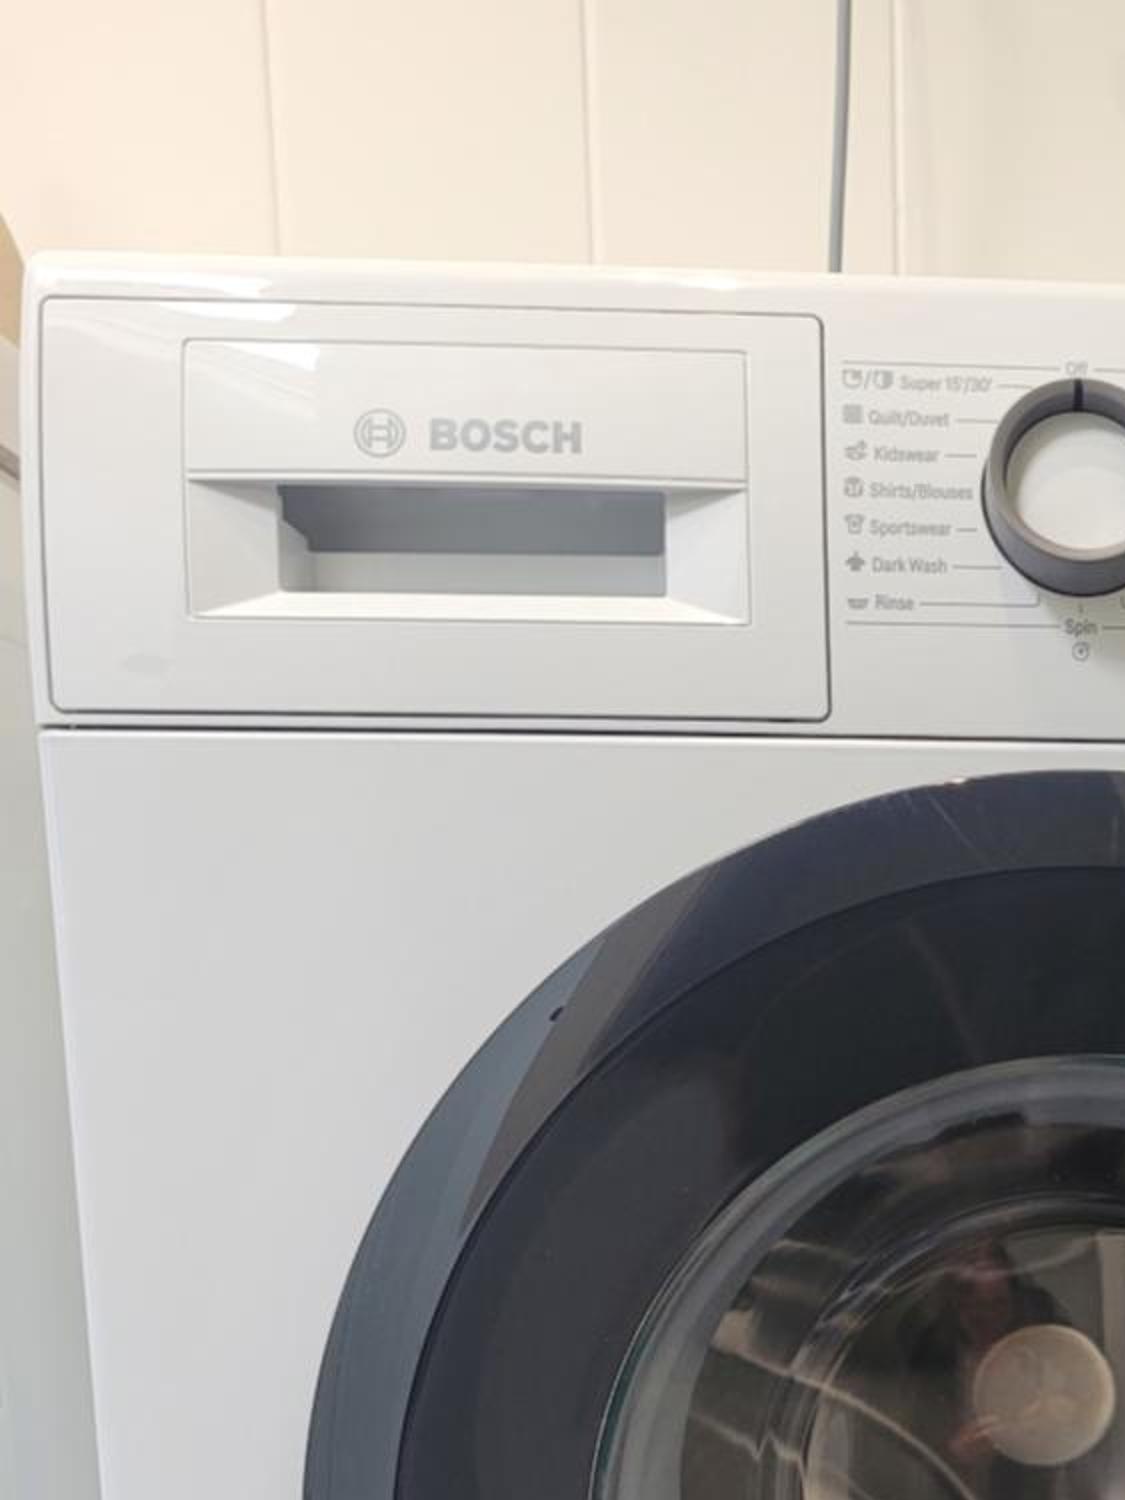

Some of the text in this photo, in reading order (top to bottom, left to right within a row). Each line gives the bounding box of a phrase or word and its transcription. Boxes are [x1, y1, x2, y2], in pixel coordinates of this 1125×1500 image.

[1065, 360, 1088, 376] Off
[900, 376, 942, 391] Super
[867, 409, 951, 427] Quilt/Duvet
[429, 417, 583, 455] BOSCH
[873, 445, 941, 462] Kidswear
[870, 481, 973, 500] Shirts/Blouses
[869, 518, 952, 538] Sportswear
[872, 556, 948, 573] Dark Wash
[874, 593, 914, 611] Rinse
[1065, 617, 1098, 639] Spin
